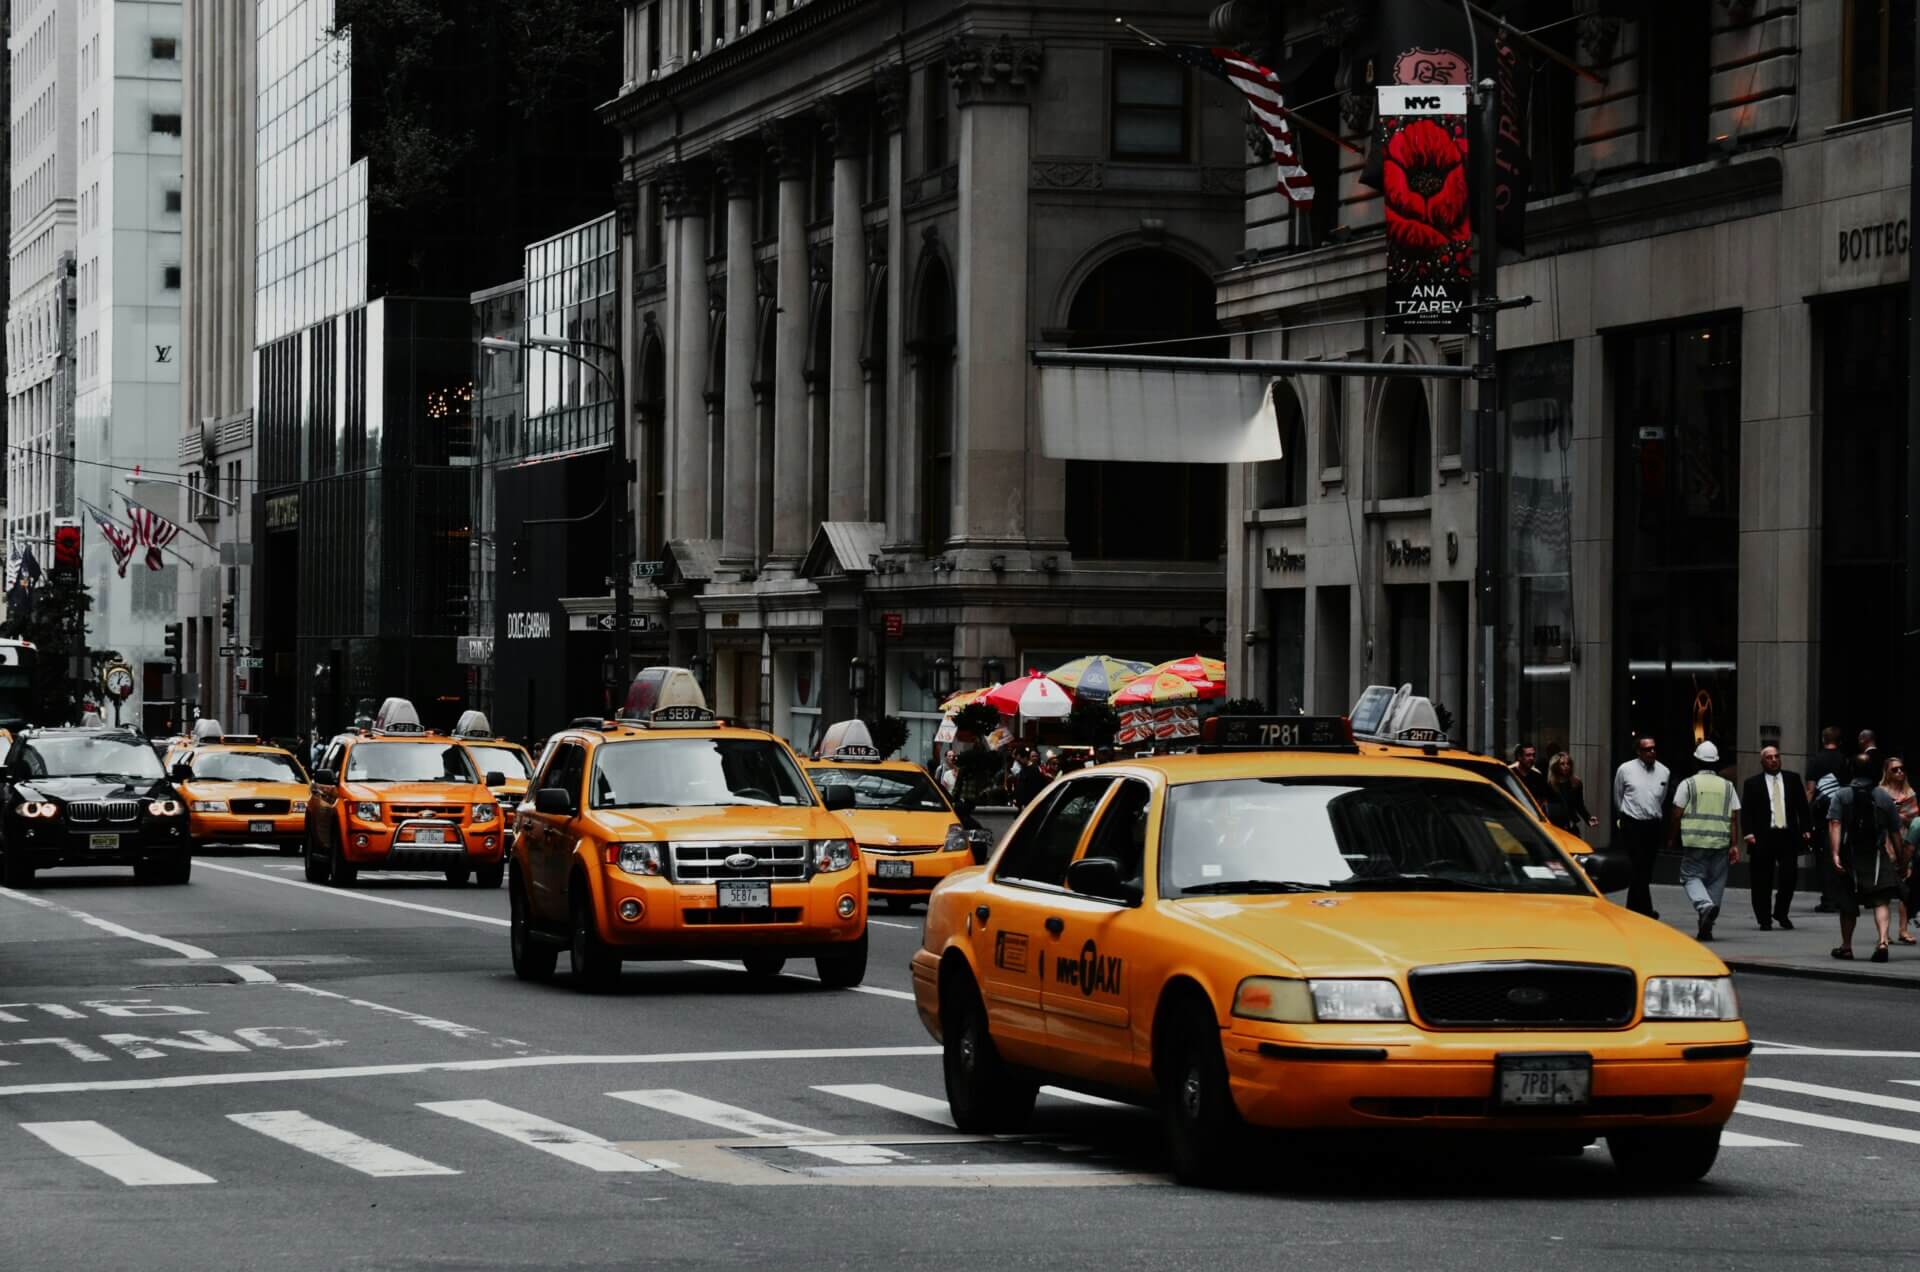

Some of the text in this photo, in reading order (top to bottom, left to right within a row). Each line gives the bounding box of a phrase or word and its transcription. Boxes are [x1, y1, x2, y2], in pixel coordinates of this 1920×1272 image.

[1404, 97, 1441, 109] NYC
[1411, 284, 1448, 298] ANA
[1395, 300, 1463, 314] TZAREV
[668, 707, 697, 720] 5E87
[1258, 724, 1300, 745] 7P81
[1410, 729, 1435, 741] 2H77
[730, 889, 753, 902] 5E87
